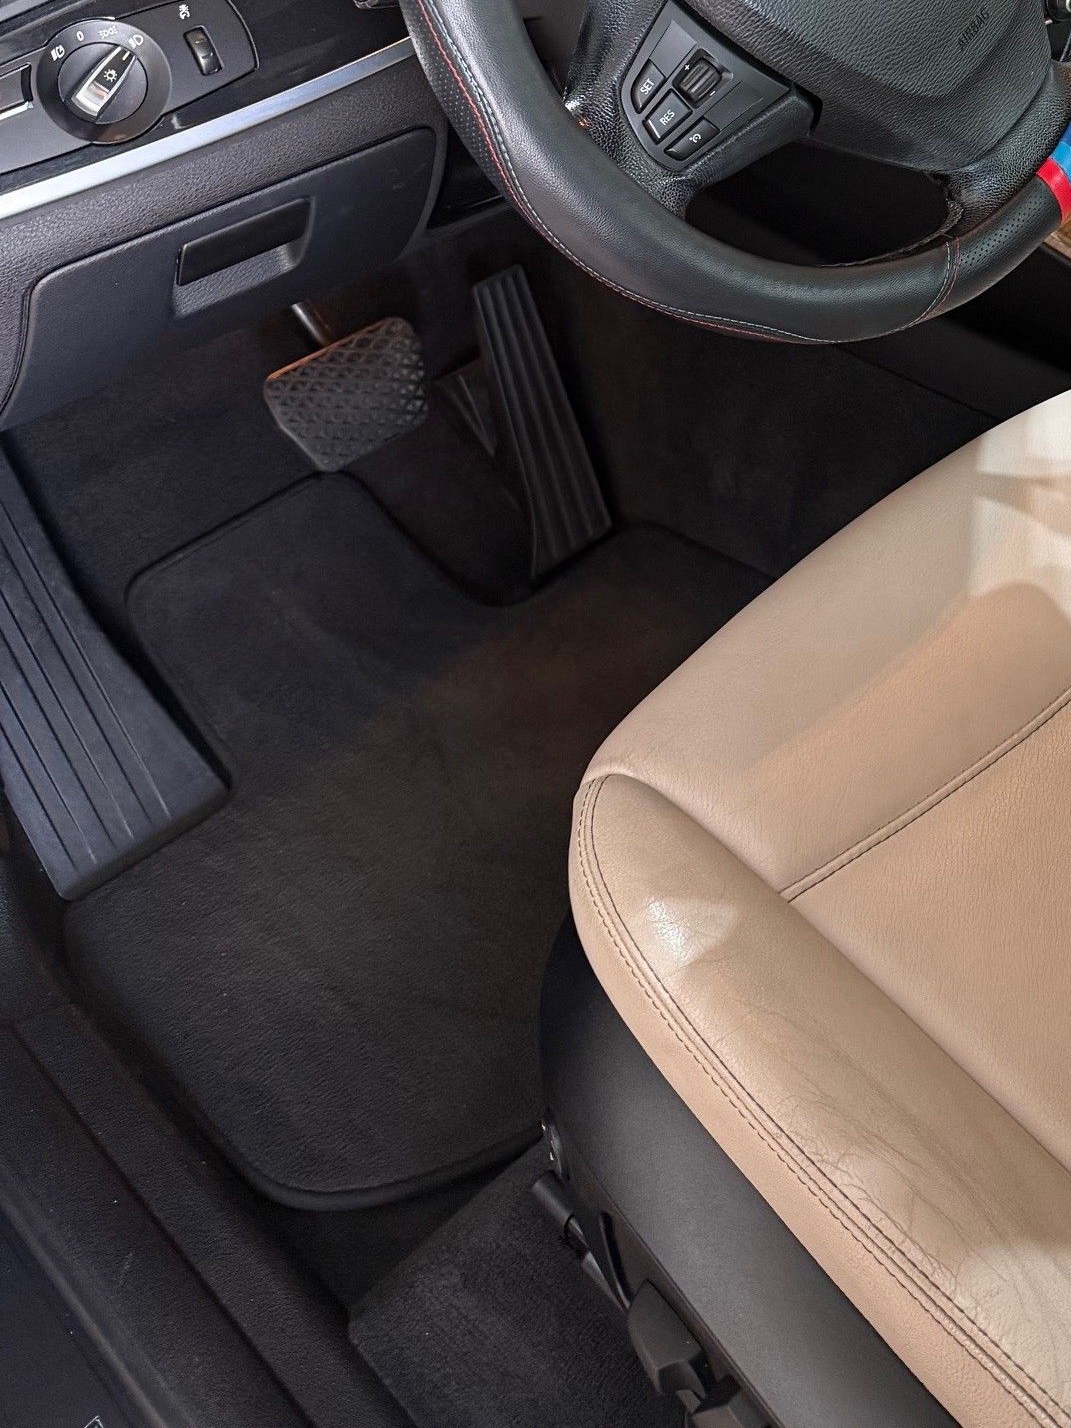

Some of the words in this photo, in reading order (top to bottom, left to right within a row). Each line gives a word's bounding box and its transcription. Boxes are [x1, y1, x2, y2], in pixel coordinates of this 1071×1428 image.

[76, 31, 84, 42] 0
[640, 80, 655, 95] SET
[659, 109, 676, 126] RES
